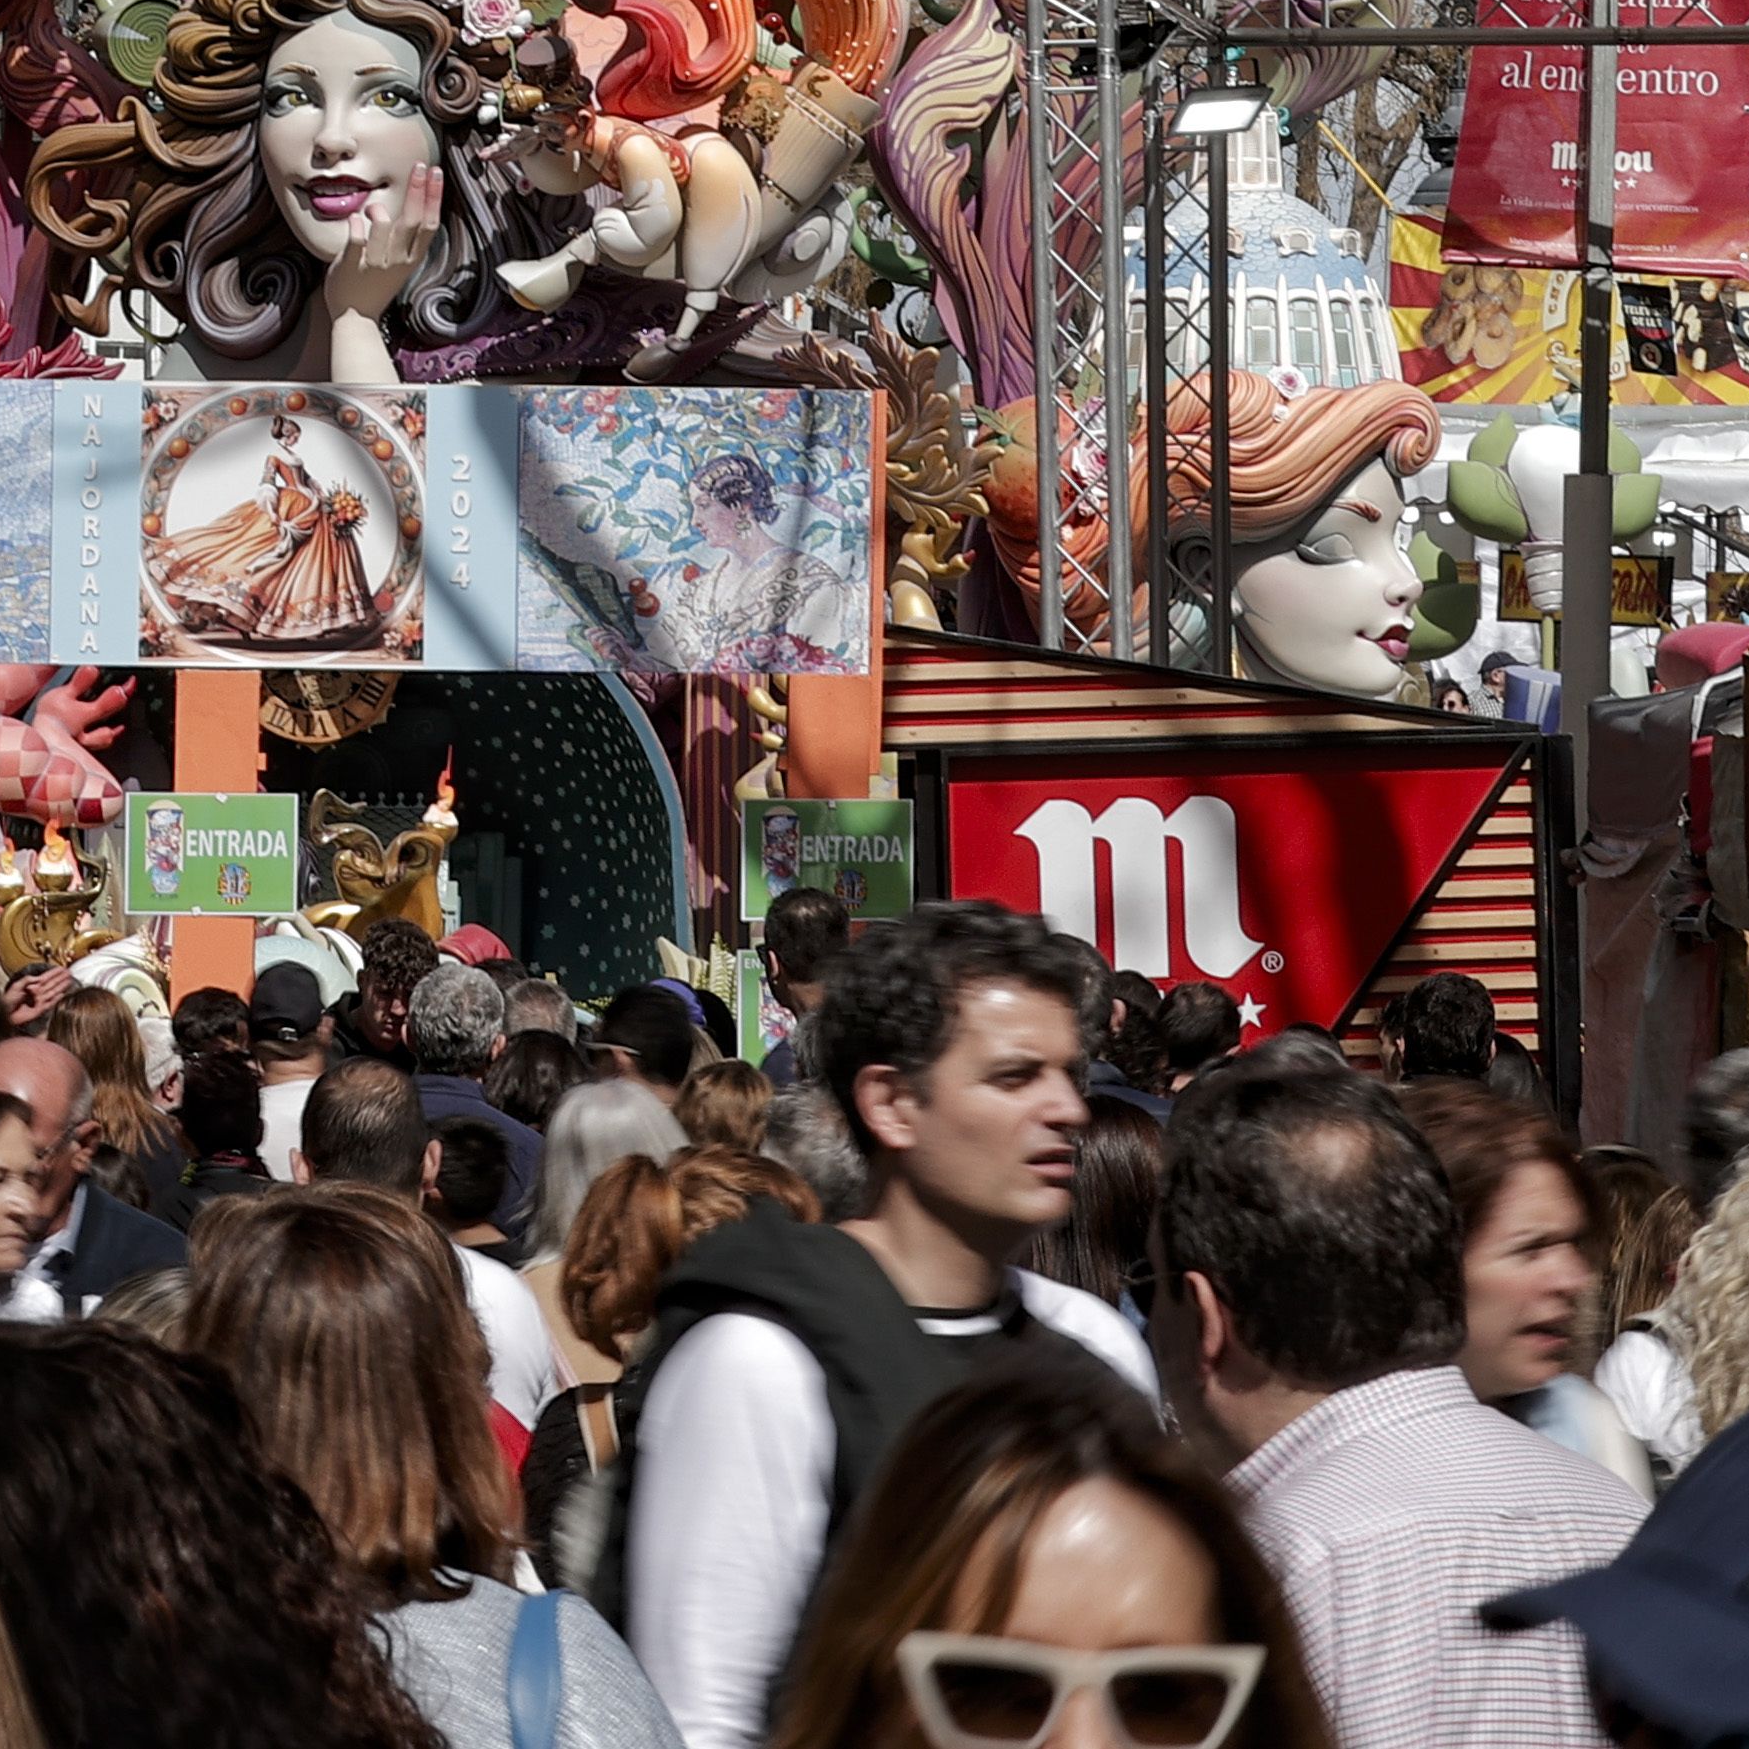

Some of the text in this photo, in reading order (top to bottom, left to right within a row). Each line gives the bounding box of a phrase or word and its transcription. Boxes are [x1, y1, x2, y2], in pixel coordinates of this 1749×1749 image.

[1501, 50, 1532, 90] al
[450, 453, 472, 590] 2024
[185, 829, 289, 858] ENTRADA
[801, 835, 904, 863] ENTRADA
